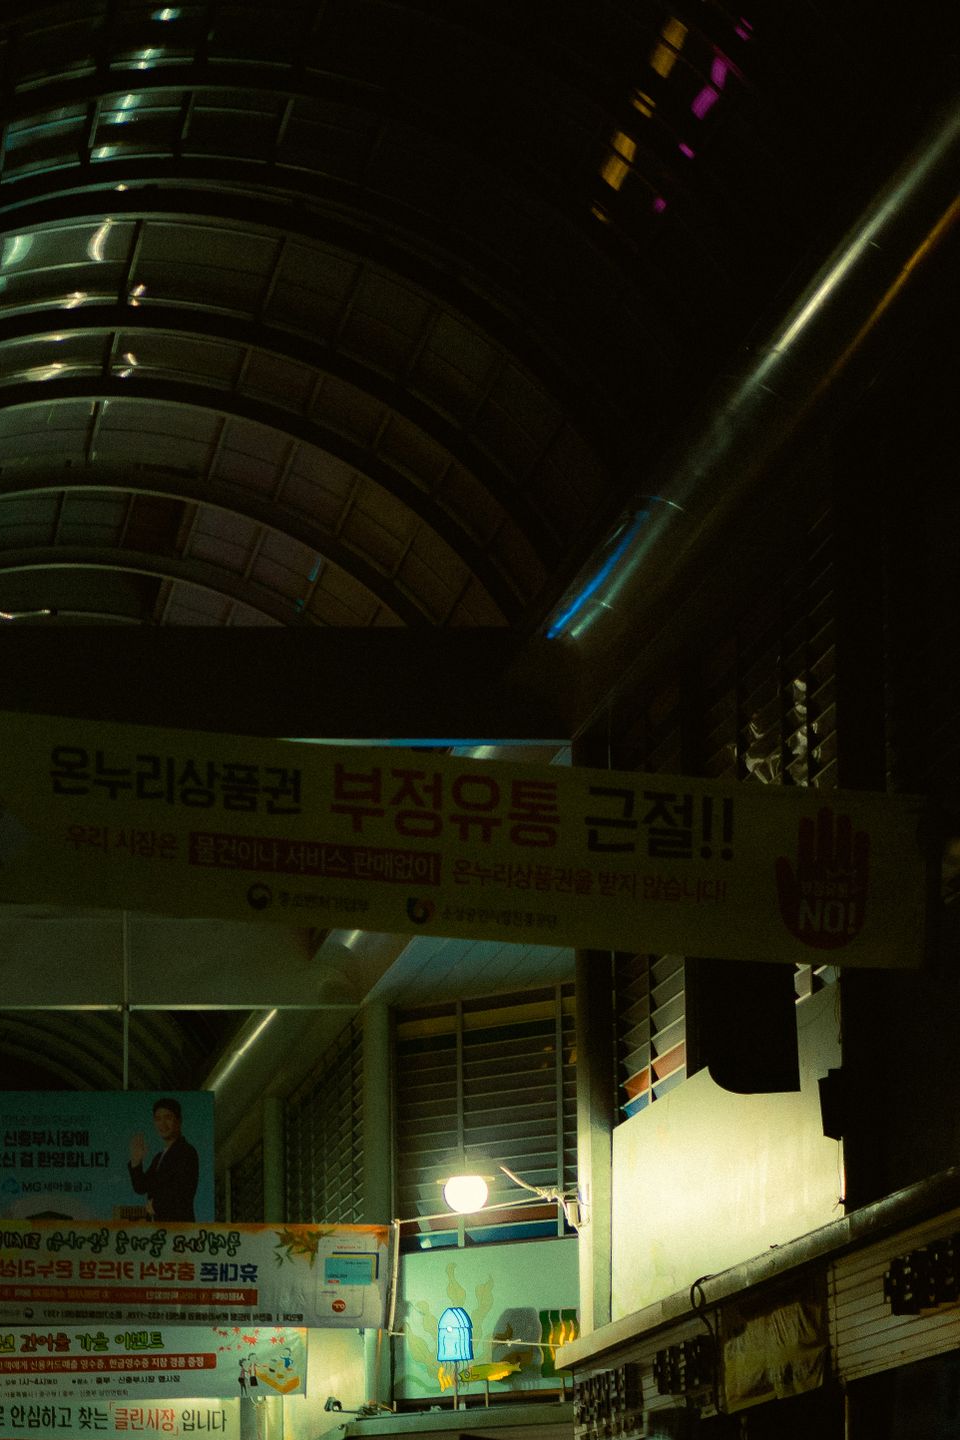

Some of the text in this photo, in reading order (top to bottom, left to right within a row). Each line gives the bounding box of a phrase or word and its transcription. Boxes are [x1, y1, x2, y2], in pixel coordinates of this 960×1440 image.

[49, 744, 303, 815] 온누리상품권
[330, 763, 561, 848] 부정유통
[584, 784, 735, 862] 근절!!
[66, 824, 109, 851] 우리
[116, 829, 178, 859] 시장은
[195, 835, 280, 870] 물건이나
[285, 842, 349, 874] 서비스
[352, 848, 436, 883] 판매없이
[452, 857, 594, 896] 온누리상품권을
[598, 871, 637, 898] 받지
[798, 898, 857, 934] NO!
[37, 1150, 110, 1168] 환영합니다
[75, 1331, 110, 1352] 가을
[114, 1331, 165, 1351] 이벤트
[10, 1404, 72, 1429] 안심하고
[79, 1406, 108, 1430] 찾는
[181, 1409, 228, 1432] 입니다
